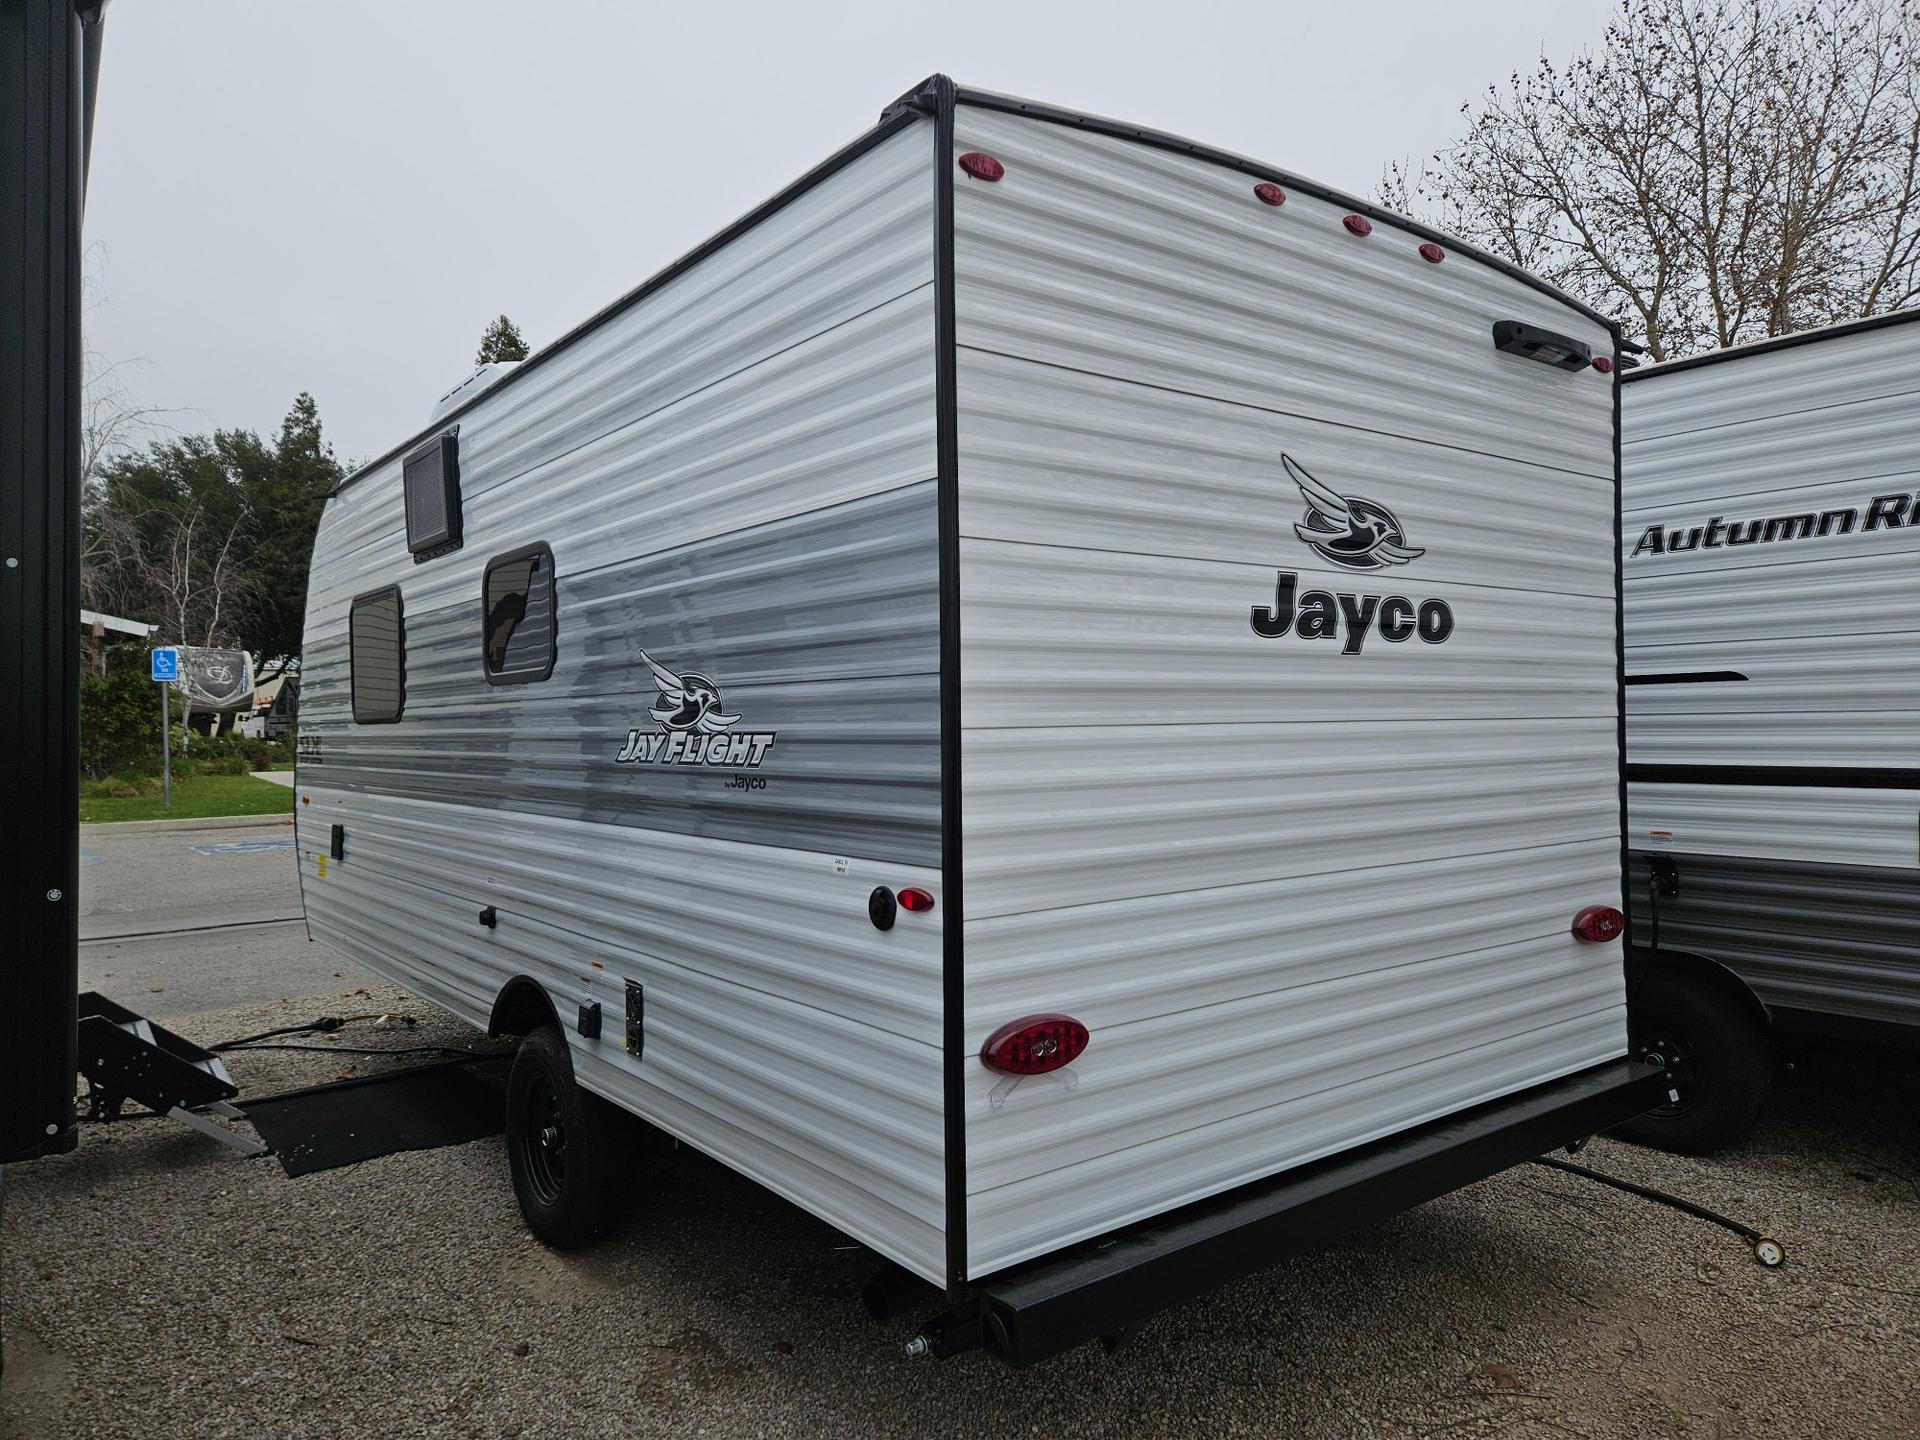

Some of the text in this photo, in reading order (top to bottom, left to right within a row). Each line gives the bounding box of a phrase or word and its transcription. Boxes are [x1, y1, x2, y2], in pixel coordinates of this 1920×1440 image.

[1629, 508, 1859, 558] Autumn
[1250, 571, 1455, 655] Jayco
[615, 729, 779, 769] JAY FLIGHT
[731, 774, 766, 792] Jayco
